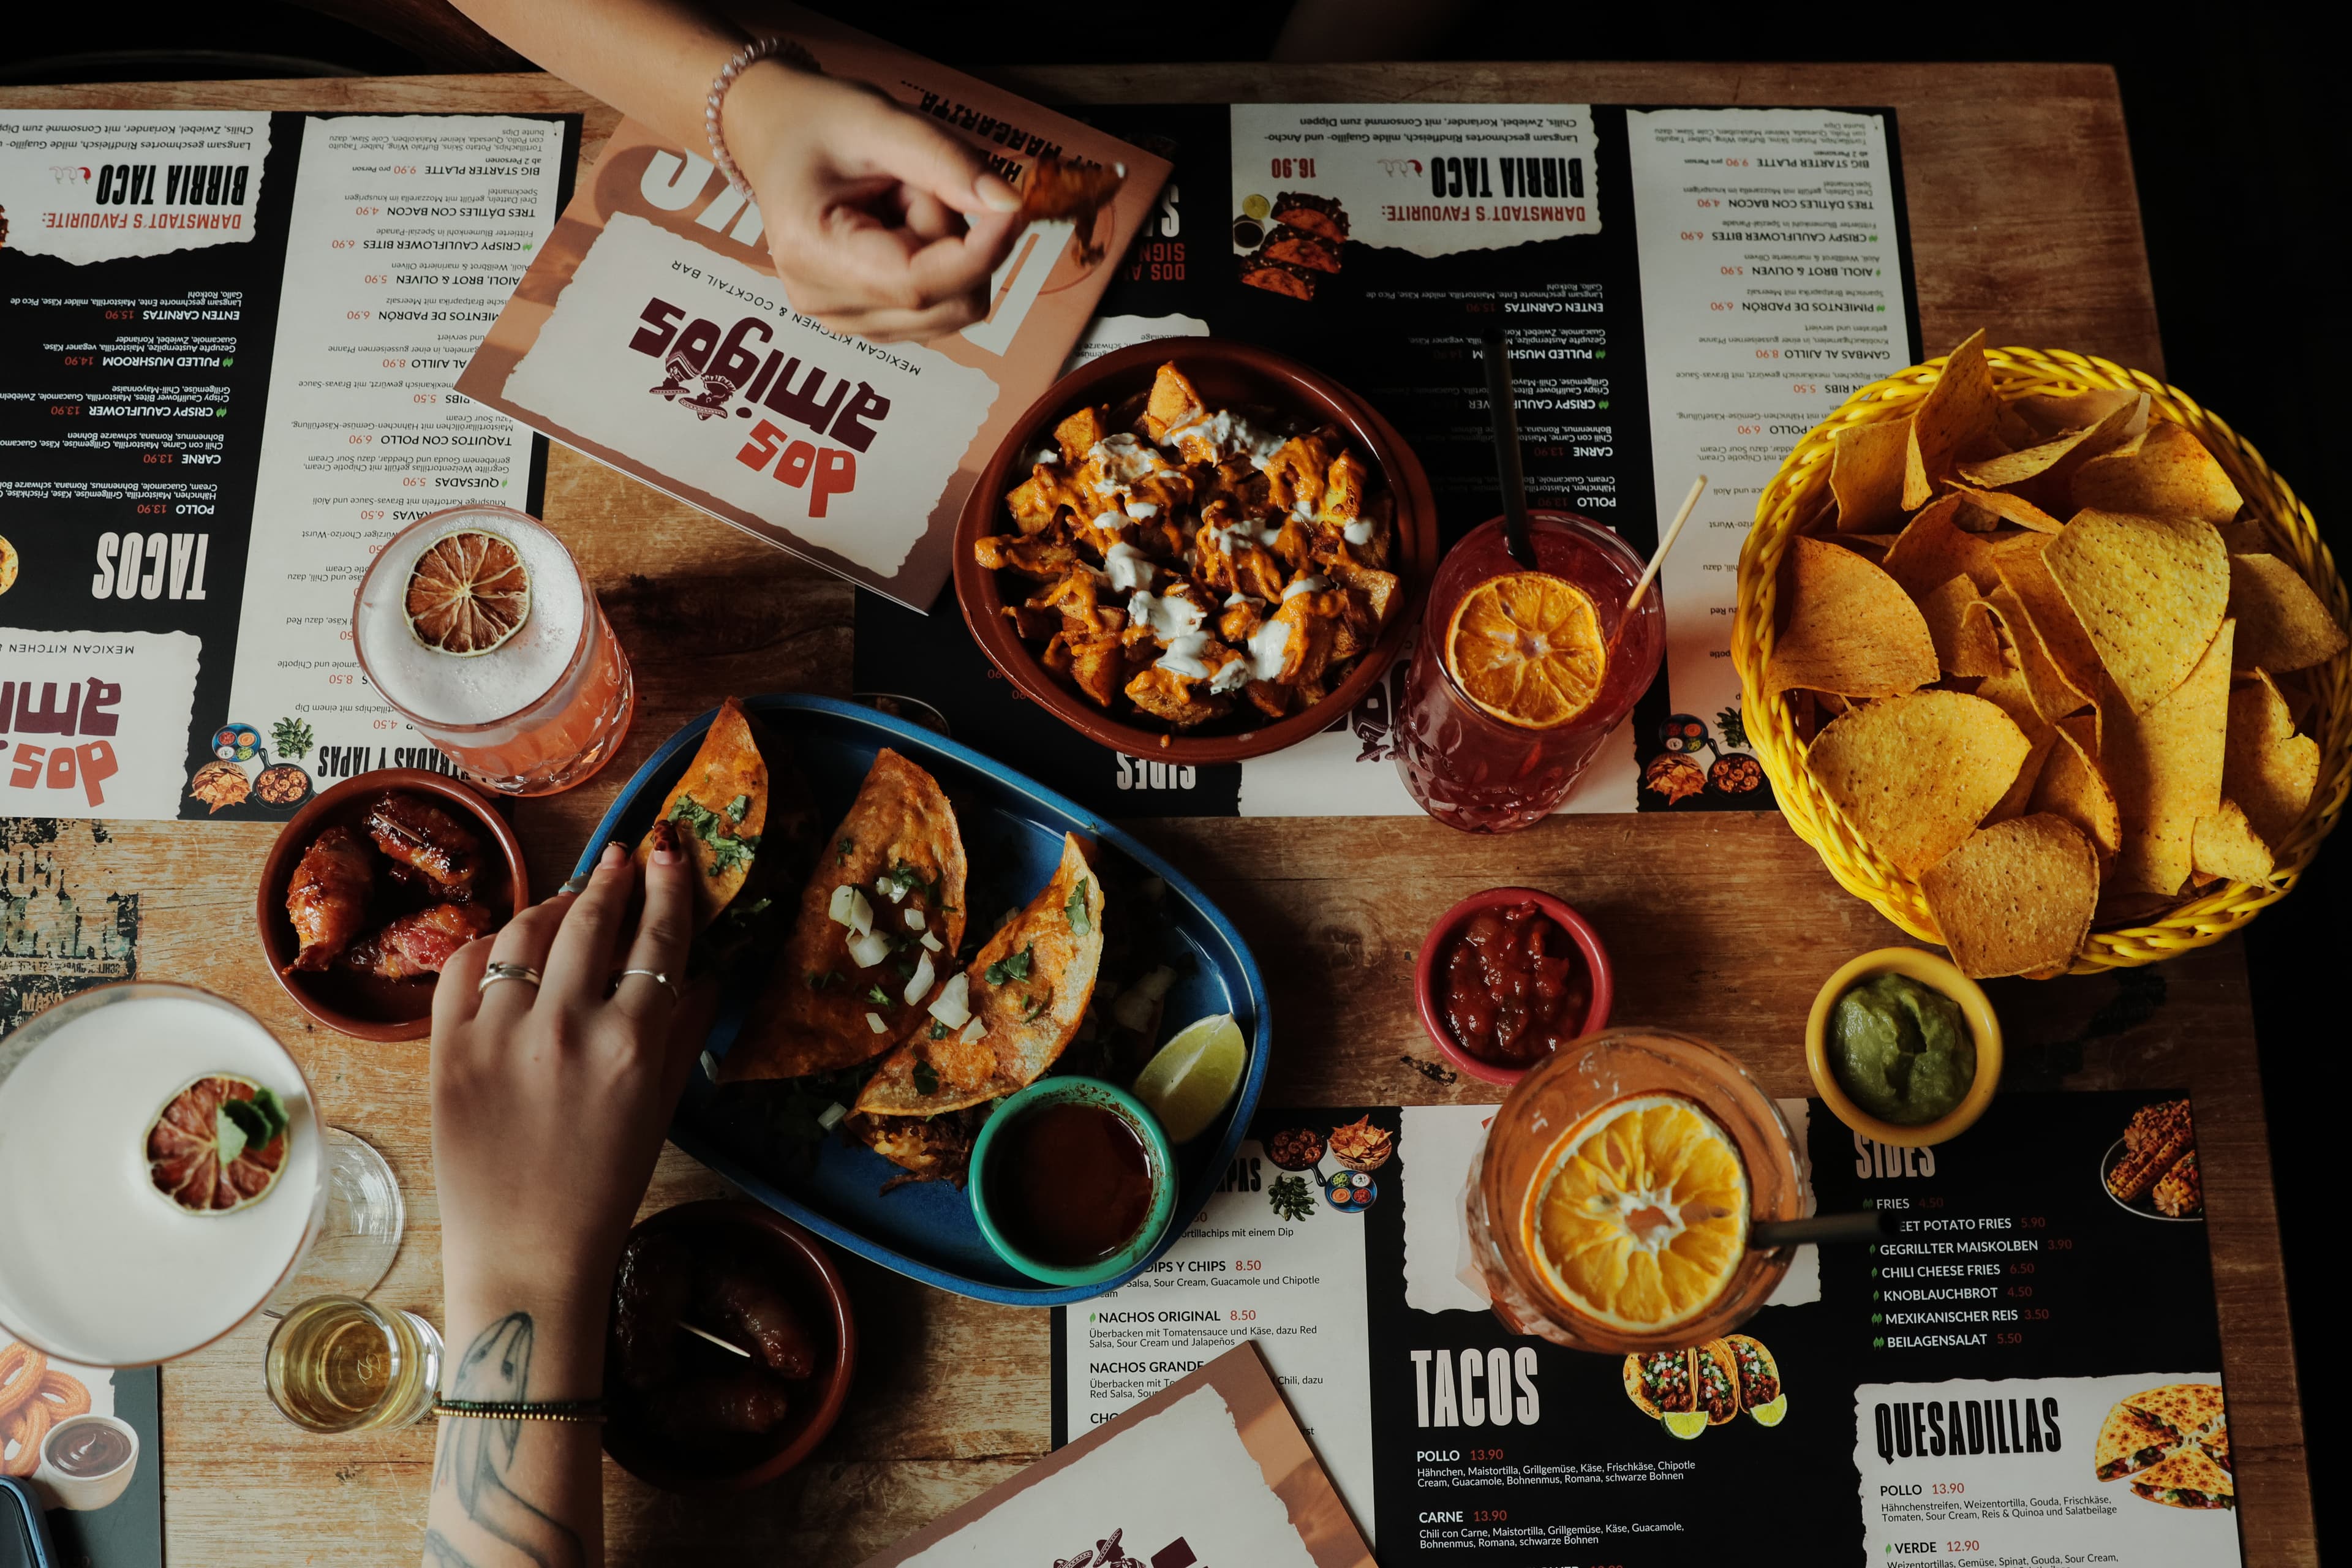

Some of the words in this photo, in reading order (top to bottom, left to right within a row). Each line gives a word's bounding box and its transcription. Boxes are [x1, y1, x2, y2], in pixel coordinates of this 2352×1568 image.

[393, 165, 417, 175] 9.90
[425, 166, 466, 175] PLATTE
[469, 166, 518, 175] STARTER
[521, 167, 540, 176] BIG
[1271, 157, 1317, 179] 16.90
[1431, 157, 1493, 198] TACO
[1499, 157, 1585, 198] BIRRIA
[96, 165, 156, 205] TACO
[166, 165, 249, 206] BIRRIA
[355, 206, 379, 216] 4.90
[387, 207, 428, 216] BACON
[431, 208, 457, 216] CON
[459, 208, 505, 219] DÁTILES
[508, 208, 536, 217] TRES
[1381, 205, 1470, 222] FAVOURITE:
[42, 213, 128, 228] FAVOURITE:
[1680, 231, 1704, 240] 6.90
[1711, 232, 1743, 241] BITES
[1745, 232, 1826, 242] CAULIFLOWER
[1828, 233, 1868, 243] CRISPY
[331, 240, 355, 249] 6.90
[363, 240, 394, 249] BITES
[397, 240, 478, 250] CAULIFLOWER
[481, 241, 521, 251] CRISPY
[671, 260, 701, 279] BAR
[1150, 263, 1185, 281] DOS
[364, 274, 386, 284] 5.90
[396, 275, 439, 284] OLIVEN
[442, 276, 450, 285] &
[452, 276, 484, 285] BROT
[706, 274, 774, 311] COCKTAIL
[1504, 303, 1562, 312] CARNITAS
[1565, 303, 1604, 312] ENTEN
[1710, 301, 1733, 311] 6.90
[1742, 303, 1792, 313] PADRÓN
[1795, 302, 1809, 311] DE
[1812, 303, 1874, 312] PIMIENTOS
[105, 310, 133, 320] 15.90
[143, 310, 200, 320] CARNITAS
[202, 311, 240, 320] ENTEN
[347, 311, 370, 320] 6.90
[379, 311, 428, 322] PADRÓN
[431, 311, 447, 321] DE
[450, 312, 499, 321] MIENTOS
[778, 306, 788, 317] &
[857, 341, 921, 376] MEXICAN
[1548, 349, 1593, 359] PULLED
[1755, 349, 1779, 359] 8.90
[1784, 349, 1822, 359] AJILLO
[1825, 350, 1839, 359] AL
[1841, 350, 1890, 360] GAMBAS
[64, 356, 92, 366] 14.90
[102, 356, 175, 367] MUSHROOM
[176, 356, 221, 367] PULLED
[382, 359, 406, 368] 8.90
[411, 359, 450, 368] AJILLO
[453, 360, 467, 369] AL
[628, 296, 891, 453] amigos
[1793, 383, 1816, 394] 5.50
[1825, 384, 1850, 393] RIBS
[413, 394, 437, 404] 5.50
[1555, 399, 1596, 409] CRISPY
[50, 405, 79, 415] 13.90
[89, 406, 172, 417] CAULIFLOWER
[173, 407, 214, 417] CRISPY
[1737, 425, 1760, 435] 6.90
[1769, 425, 1807, 436] POLLO
[349, 434, 372, 445] 6.90
[380, 435, 420, 445] POLLO
[422, 435, 449, 445] CON
[451, 435, 512, 446] TAQUITOS
[1573, 447, 1613, 456] CARNE
[143, 454, 172, 464] 13.90
[181, 454, 222, 464] CARNE
[333, 462, 368, 472] Chipotle
[385, 462, 410, 472] gefüllt
[412, 465, 473, 473] Weizentortillas
[475, 462, 510, 474] Gegrillte
[736, 418, 856, 518] dos
[402, 477, 426, 486] 5.90
[435, 477, 499, 488] QUESADAS
[1577, 497, 1616, 507] POLLO
[137, 504, 167, 514] 13.90
[175, 505, 215, 514] POLLO
[360, 510, 385, 520] 6.50
[91, 532, 209, 600] TACOS
[9, 644, 67, 654] KITCHEN
[73, 645, 135, 654] MEXICAN
[329, 674, 353, 685] 8.50
[373, 720, 398, 729] 4.50
[9, 740, 119, 808] dos
[1853, 1131, 1936, 1179] SIDES
[1876, 1198, 1910, 1210] FRIES
[1901, 1221, 1920, 1232] EET
[1923, 1219, 1976, 1231] POTATO
[1978, 1218, 2012, 1229] FRIES
[1880, 1243, 1954, 1255] GEGRILLTER
[1956, 1240, 2038, 1253] MAISKOLBEN
[1175, 1261, 1185, 1272] Y
[1188, 1261, 1226, 1272] CHIPS
[1235, 1260, 1262, 1271] 8.50
[1882, 1267, 1914, 1278] CHILI
[1917, 1265, 1964, 1277] CHEESE
[1967, 1264, 2000, 1276] FRIES
[1883, 1287, 1998, 1302] KNOBLAUCHBROT
[1099, 1311, 1155, 1324] NACHOS
[1158, 1311, 1221, 1322] ORIGINAL
[1230, 1310, 1256, 1321] 8.50
[1885, 1310, 1989, 1325] MEXIKANISCHER
[1992, 1310, 2018, 1321] REIS
[1089, 1328, 1144, 1338] Überbacken
[1146, 1329, 1161, 1337] mit
[1163, 1328, 1228, 1337] Tomatensauce
[1230, 1326, 1248, 1336] und
[1250, 1326, 1274, 1336] Käse,
[1276, 1325, 1297, 1335] dazu
[1300, 1325, 1317, 1334] Red
[1887, 1333, 1988, 1348] BEILAGENSALAT
[1090, 1362, 1146, 1373] NACHOS
[1410, 1347, 1540, 1427] TACOS
[1874, 1397, 2062, 1465] QUESADILLAS
[1417, 1450, 1460, 1462] POLLO
[1471, 1449, 1504, 1461] 13.90
[1417, 1468, 1466, 1477] Hähnchen,
[1468, 1465, 1521, 1476] Maistortilla,
[1523, 1464, 1578, 1476] Grillgemüse,
[1580, 1463, 1605, 1473] Käse,
[1607, 1462, 1656, 1472] Frischkäse,
[1657, 1460, 1696, 1471] Chipotle
[1880, 1484, 1922, 1496] POLLO
[1932, 1482, 1965, 1494] 13.90
[1881, 1501, 1962, 1512] Hähnchenstreifen,
[1963, 1498, 2028, 1509] Weizentortilla,
[2029, 1497, 2062, 1507] Gouda,
[2064, 1495, 2112, 1510] Frischkäse,
[1419, 1511, 1464, 1523] CARNE
[1475, 1510, 1507, 1521] 13.90
[1894, 1542, 1937, 1554] VERDE
[1947, 1540, 1980, 1551] 12.90
